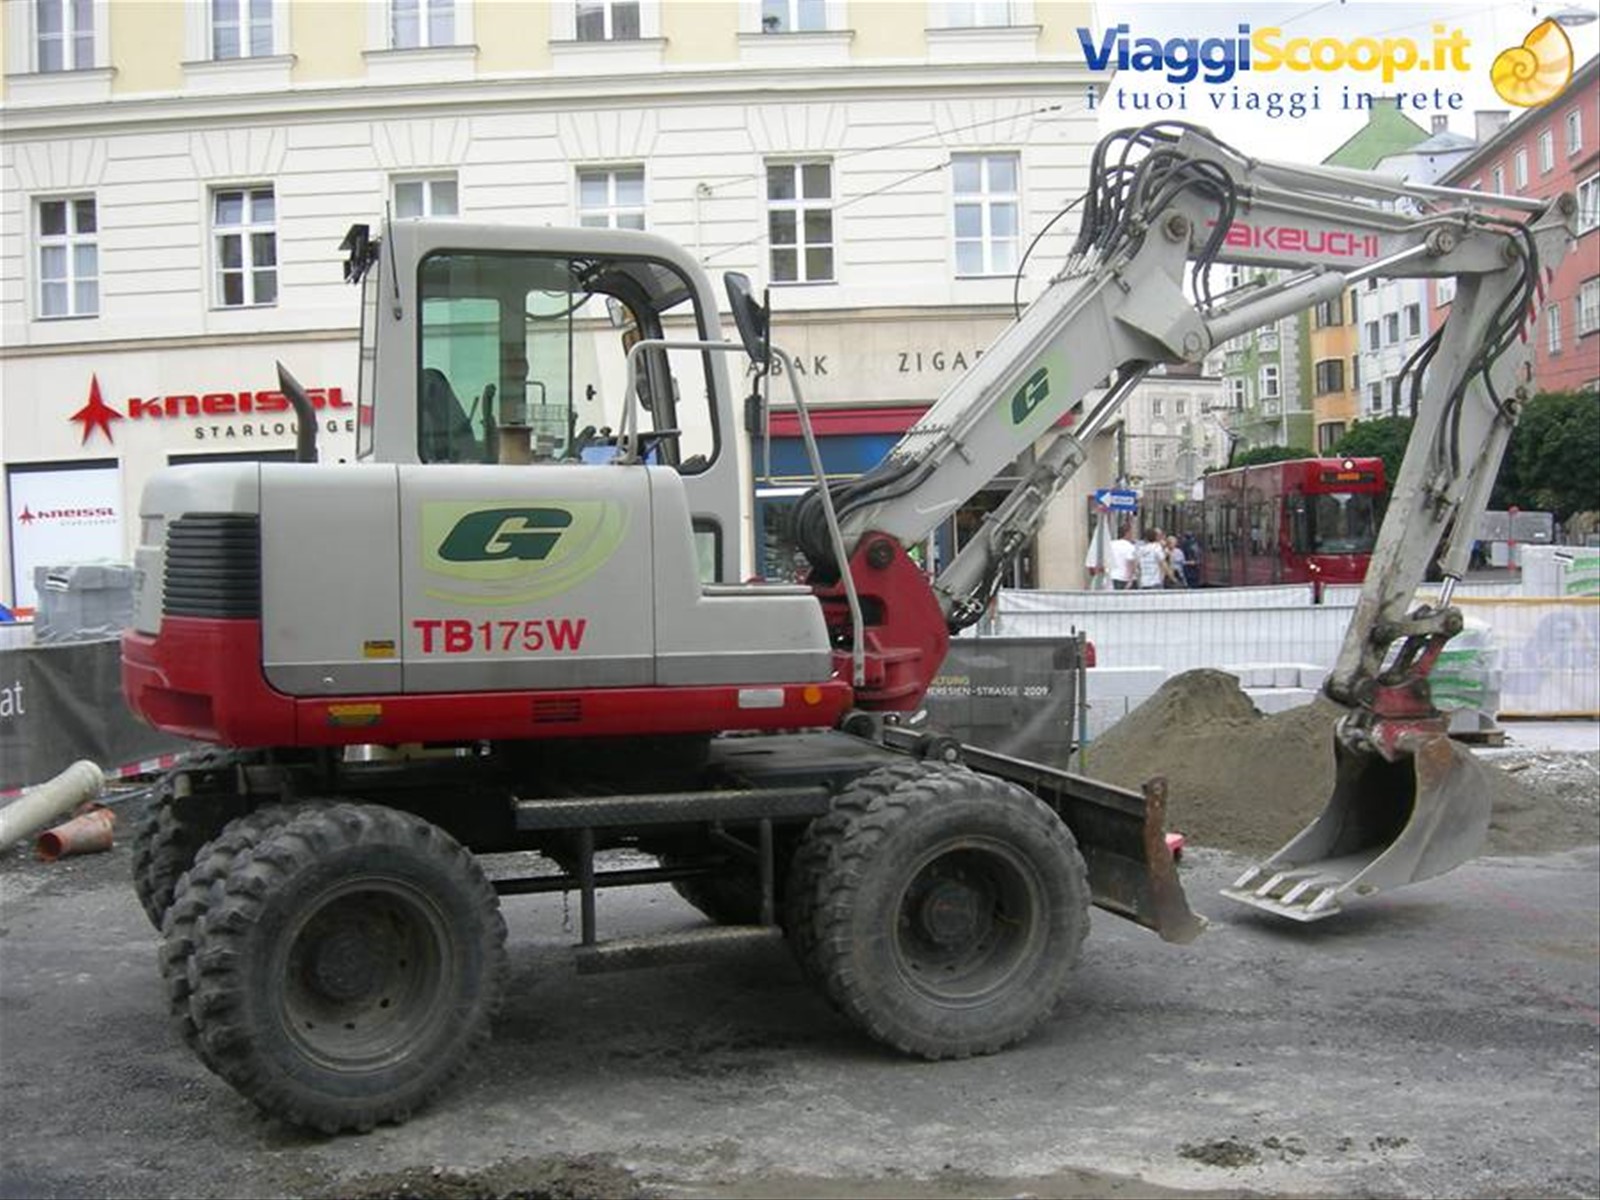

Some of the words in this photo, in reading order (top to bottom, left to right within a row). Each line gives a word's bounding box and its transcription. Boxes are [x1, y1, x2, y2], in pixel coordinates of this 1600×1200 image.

[898, 350, 984, 373] ZIGA
[195, 419, 354, 439] STARLOUGE
[437, 507, 573, 563] G
[413, 618, 587, 654] TB175W
[1023, 685, 1050, 697] 2009
